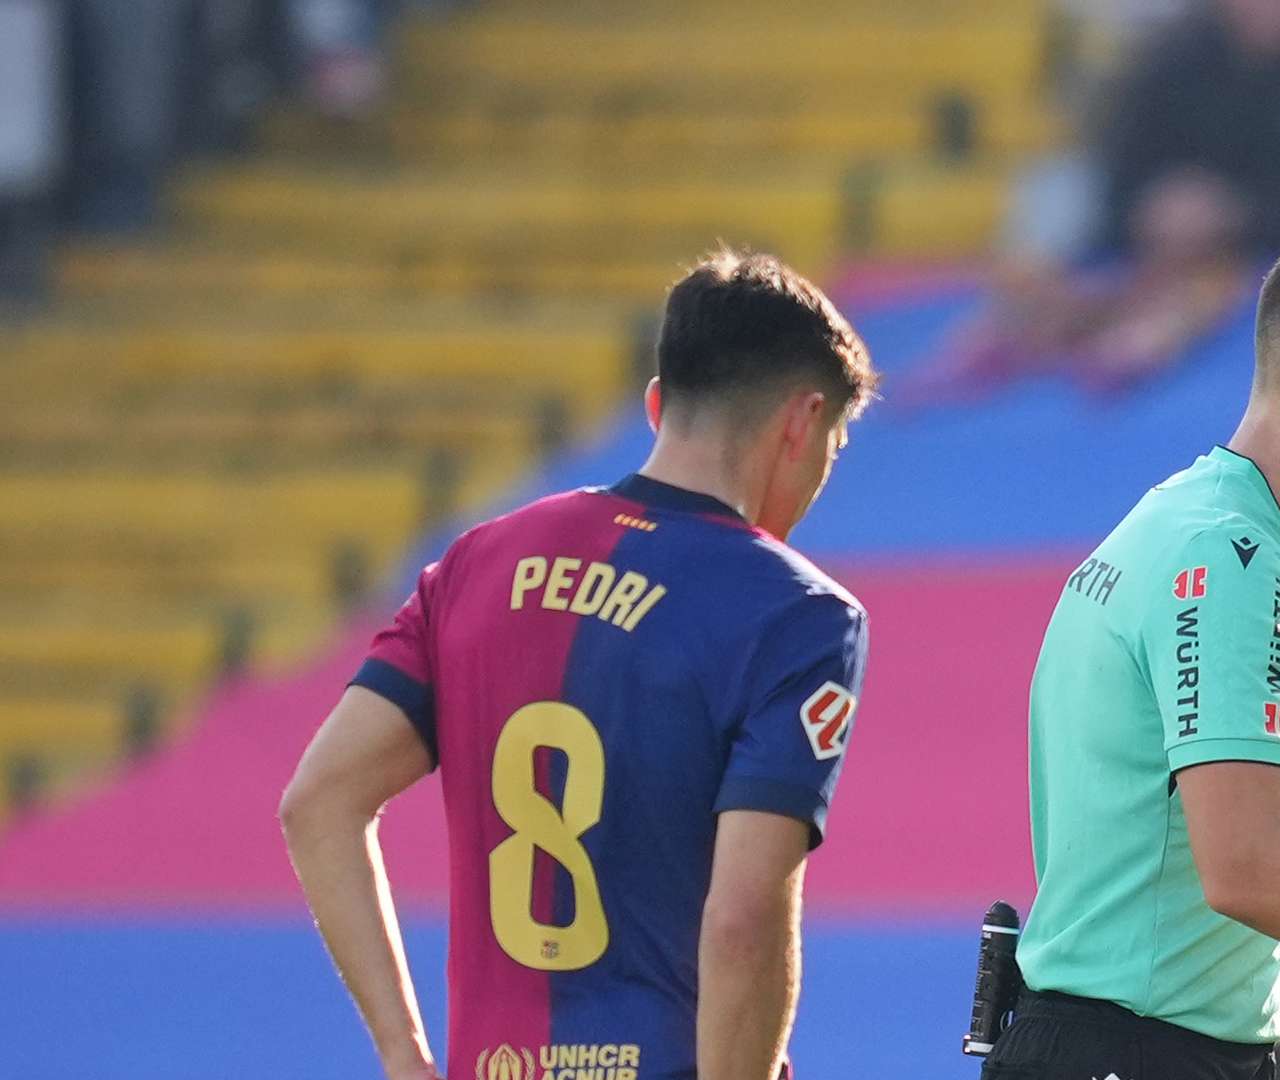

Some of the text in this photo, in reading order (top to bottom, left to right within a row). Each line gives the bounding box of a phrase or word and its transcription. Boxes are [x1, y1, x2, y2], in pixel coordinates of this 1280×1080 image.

[510, 556, 667, 632] PEDRI
[1068, 558, 1122, 606] RTH
[1175, 606, 1199, 738] WÜRTH
[489, 700, 610, 971] 8
[539, 1044, 640, 1069] UNHCR
